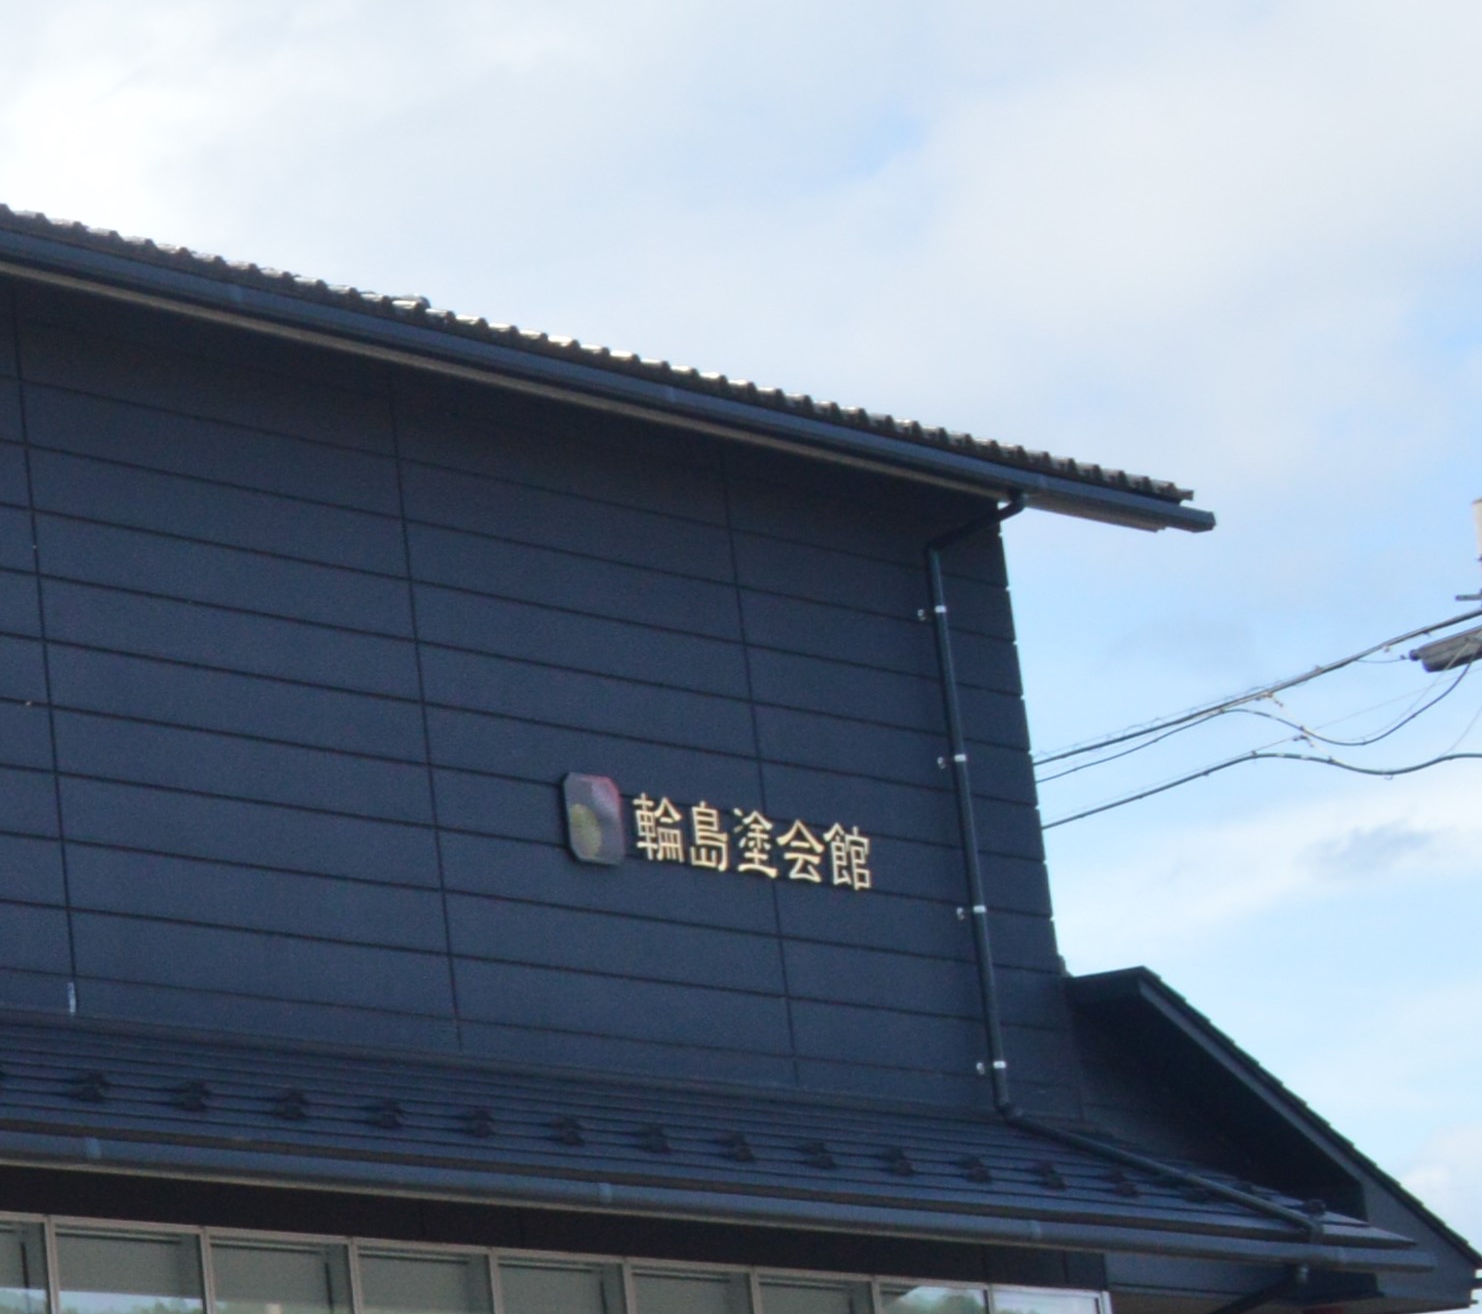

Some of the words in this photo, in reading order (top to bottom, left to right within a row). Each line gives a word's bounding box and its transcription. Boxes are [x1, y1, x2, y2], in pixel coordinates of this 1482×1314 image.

[633, 793, 872, 890] 輪島塗会館
